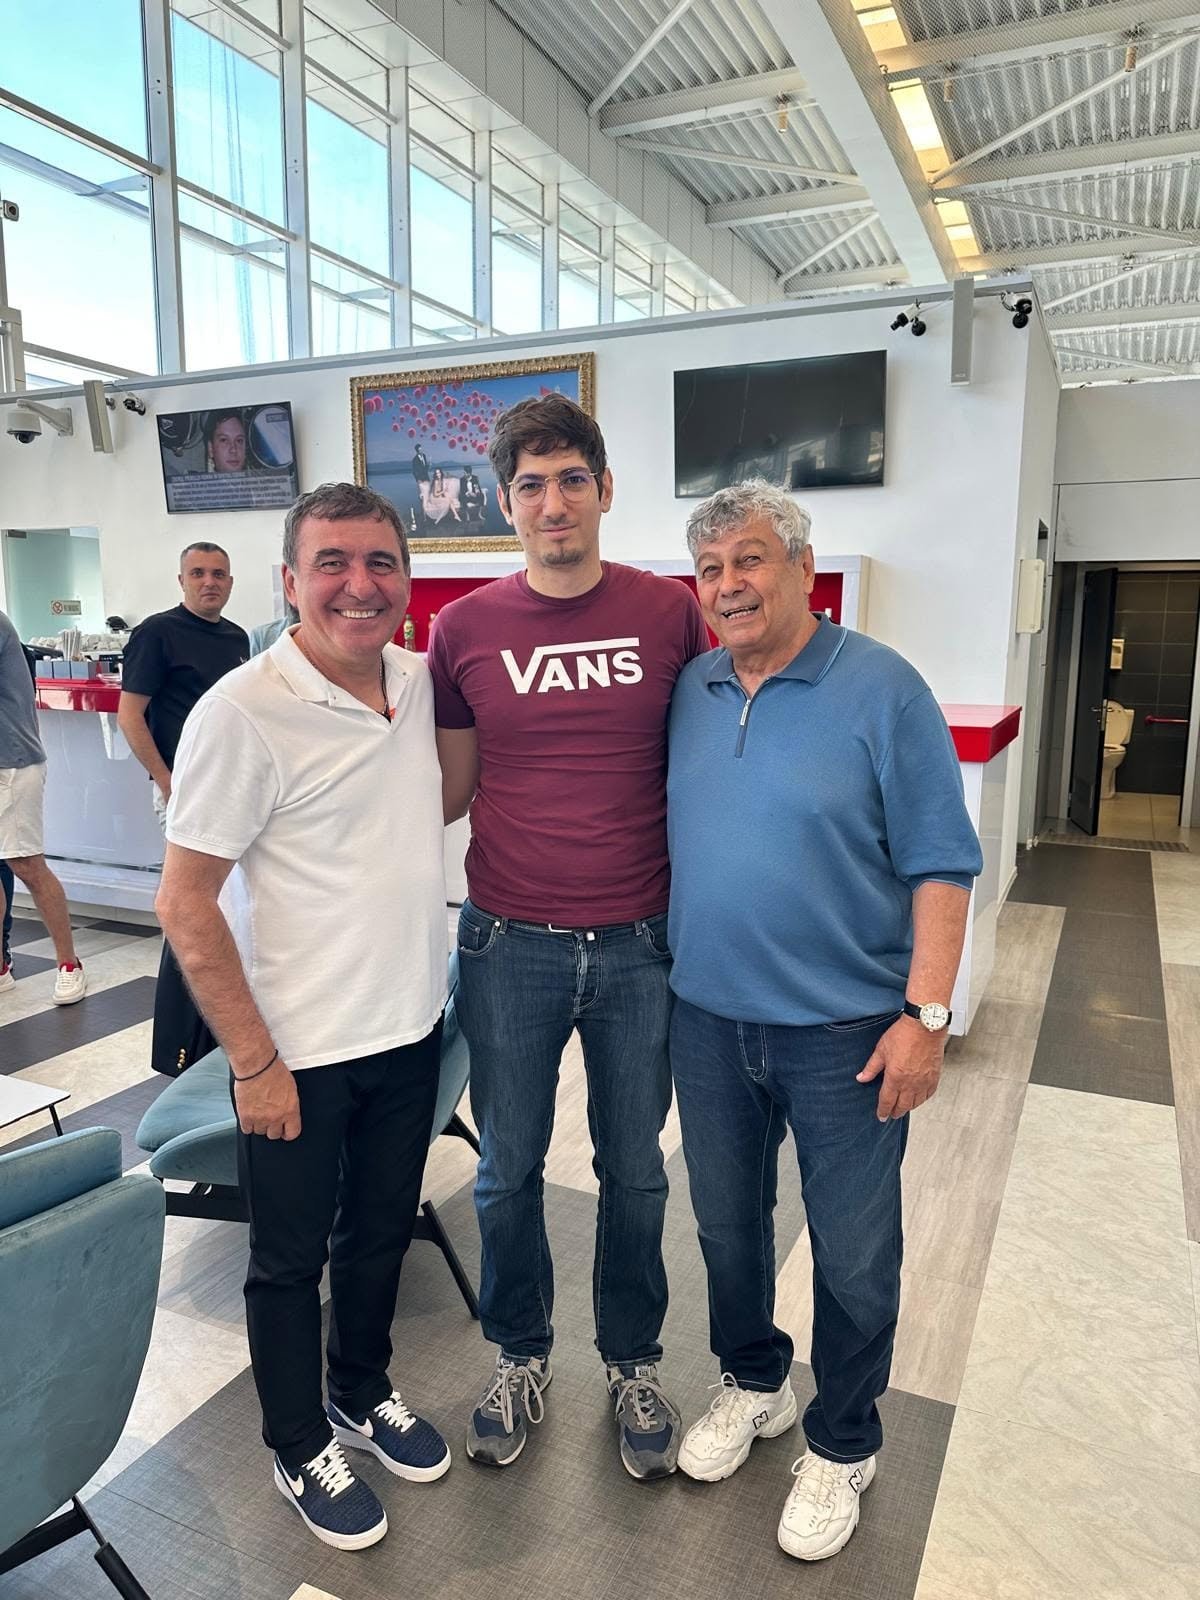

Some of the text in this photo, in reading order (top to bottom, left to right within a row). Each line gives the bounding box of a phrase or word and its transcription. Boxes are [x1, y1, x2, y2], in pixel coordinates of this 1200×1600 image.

[500, 637, 643, 694] VANS
[752, 1410, 769, 1429] N
[848, 1468, 863, 1493] N
